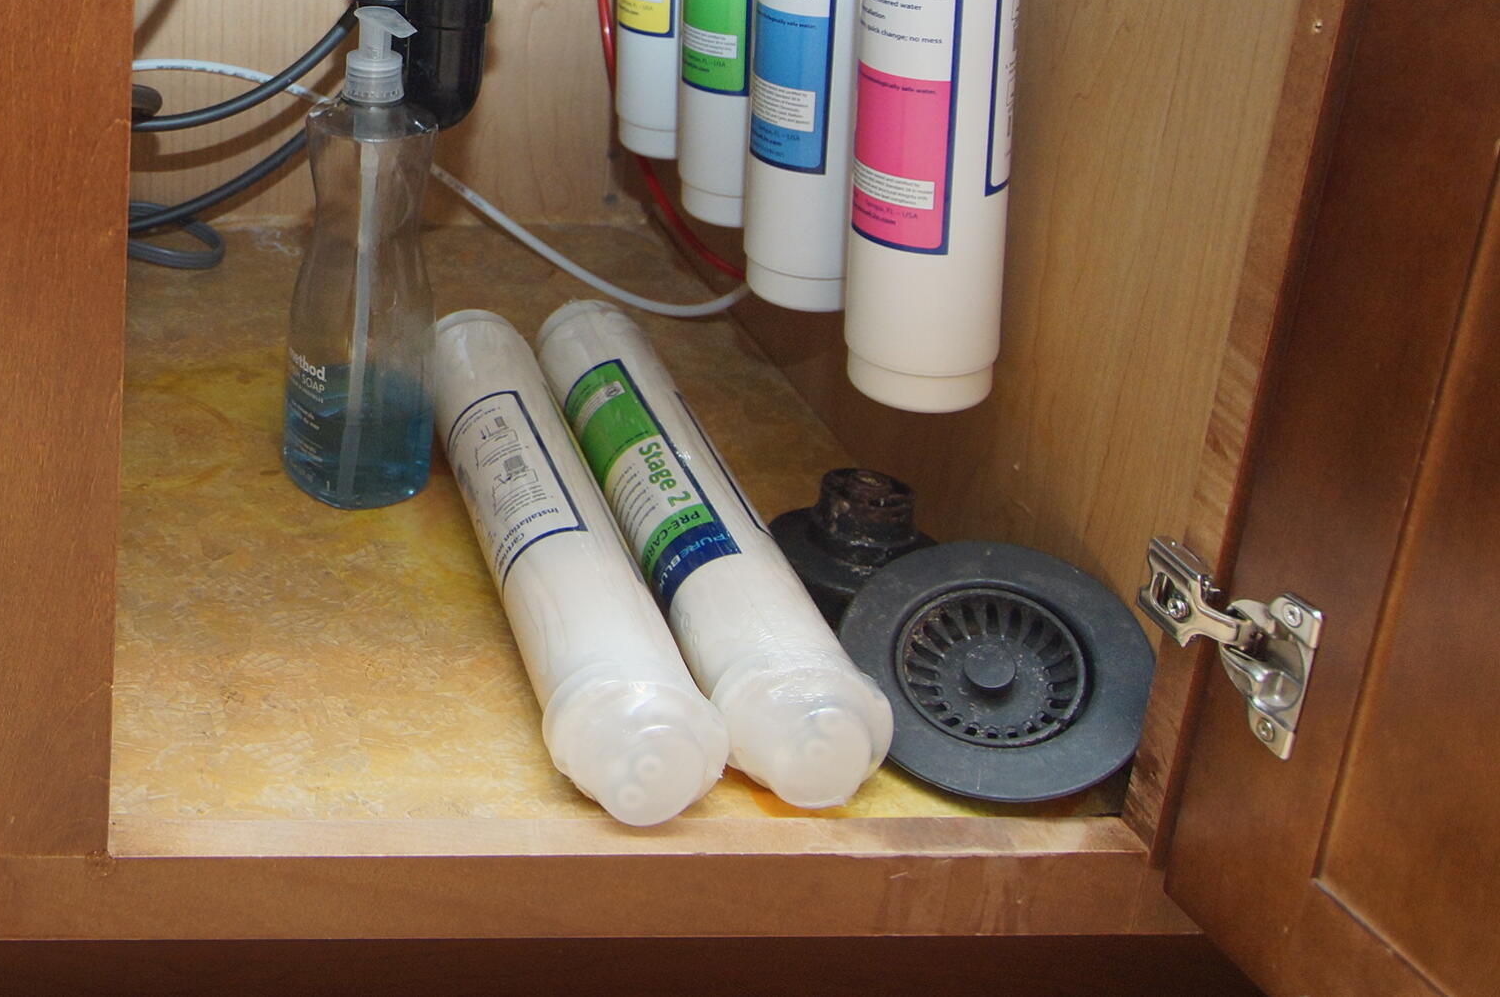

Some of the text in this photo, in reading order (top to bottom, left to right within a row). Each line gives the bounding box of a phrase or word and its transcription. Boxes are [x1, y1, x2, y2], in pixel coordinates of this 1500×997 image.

[900, 2, 922, 11] water
[880, 29, 908, 41] change;
[637, 439, 678, 492] Stage
[666, 489, 692, 508] 2
[502, 506, 560, 544] Installation
